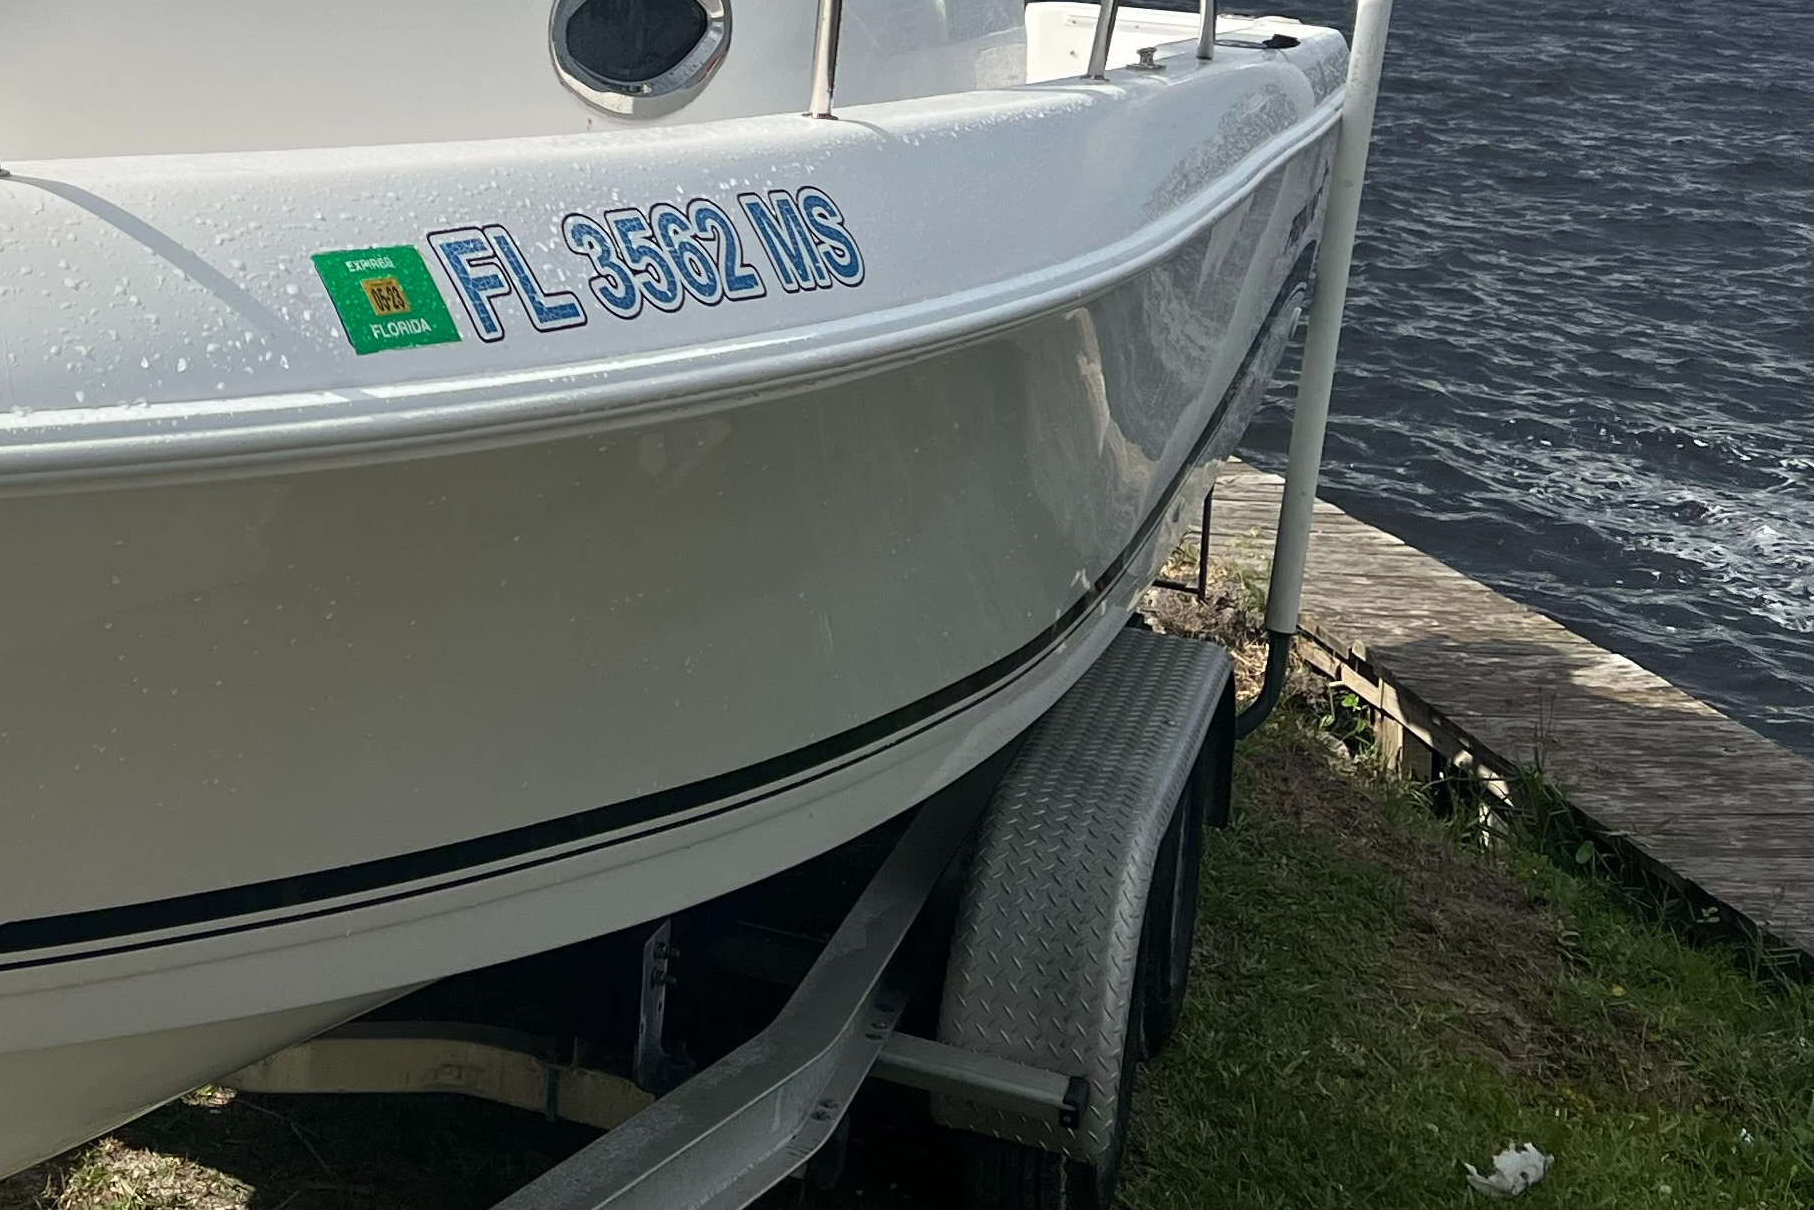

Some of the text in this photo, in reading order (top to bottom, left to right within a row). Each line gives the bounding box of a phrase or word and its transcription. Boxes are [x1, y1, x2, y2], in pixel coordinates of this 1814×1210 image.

[345, 256, 396, 273] EXPIRES
[427, 186, 865, 342] FL 3562 MS
[369, 318, 432, 339] FLORIDA
